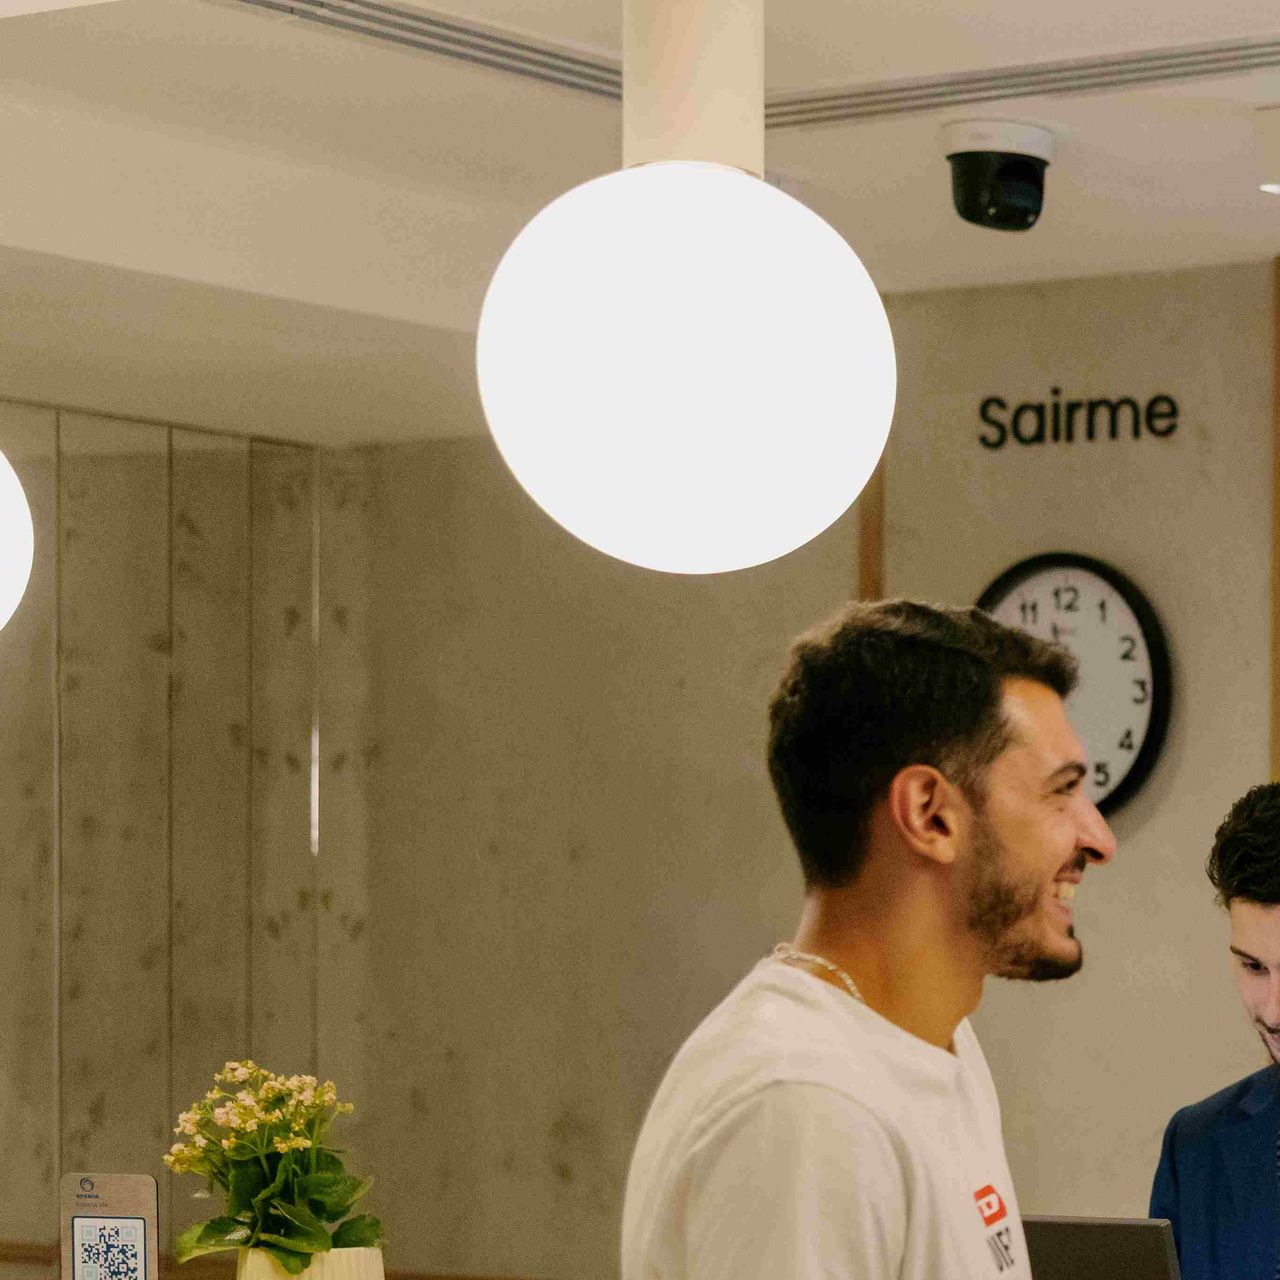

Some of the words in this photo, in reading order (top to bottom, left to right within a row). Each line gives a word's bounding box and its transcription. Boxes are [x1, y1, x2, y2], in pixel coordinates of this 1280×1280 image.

[979, 386, 1179, 451] Sairme
[1053, 586, 1080, 612] 12
[1098, 599, 1107, 622] 1
[1020, 601, 1038, 625] 11
[1119, 634, 1136, 662] 2
[1133, 679, 1148, 705] 3
[1118, 729, 1134, 751] 4
[1094, 762, 1109, 787] 5
